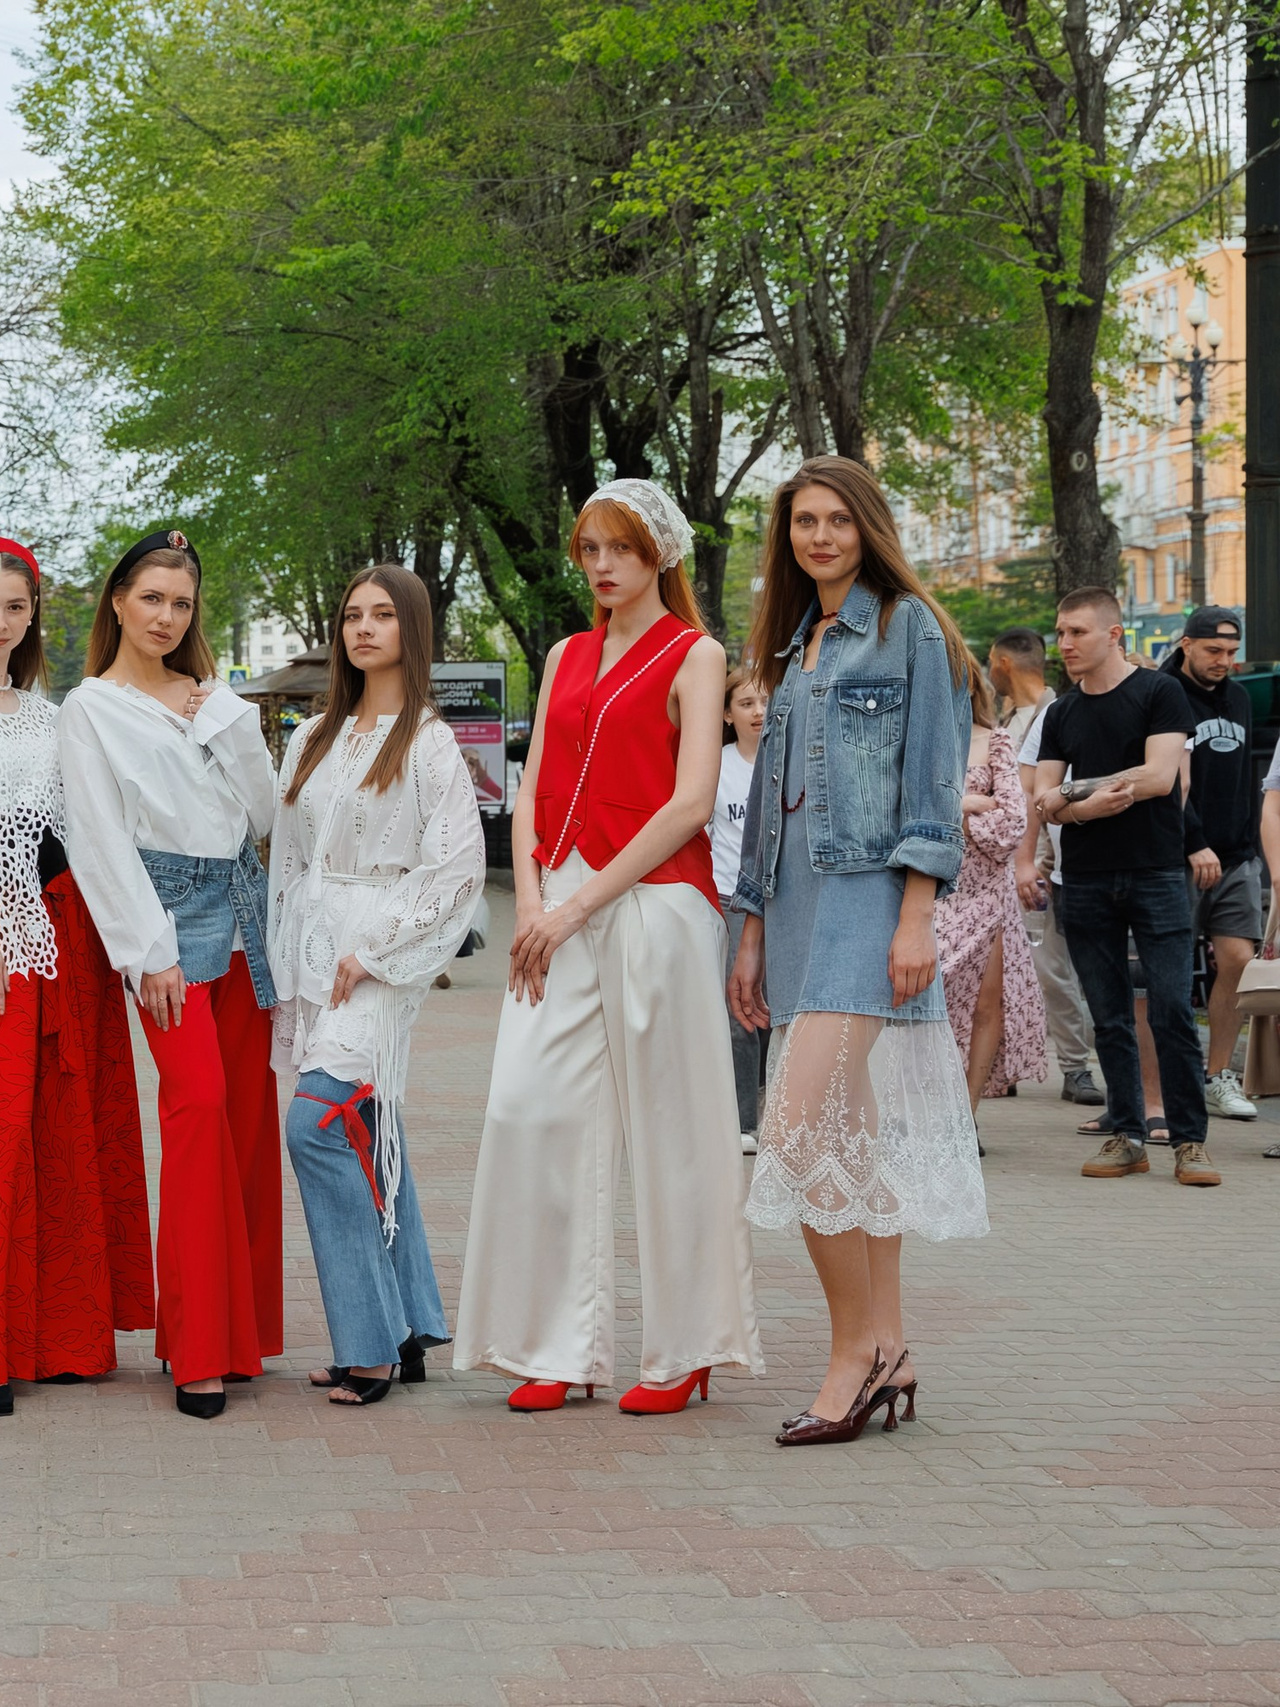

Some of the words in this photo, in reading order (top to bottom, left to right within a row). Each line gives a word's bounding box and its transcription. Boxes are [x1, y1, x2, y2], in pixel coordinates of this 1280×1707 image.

[433, 682, 484, 690] ЕХОДИТЕ
[437, 698, 470, 706] ЕРОМ
[728, 803, 745, 822] NA
